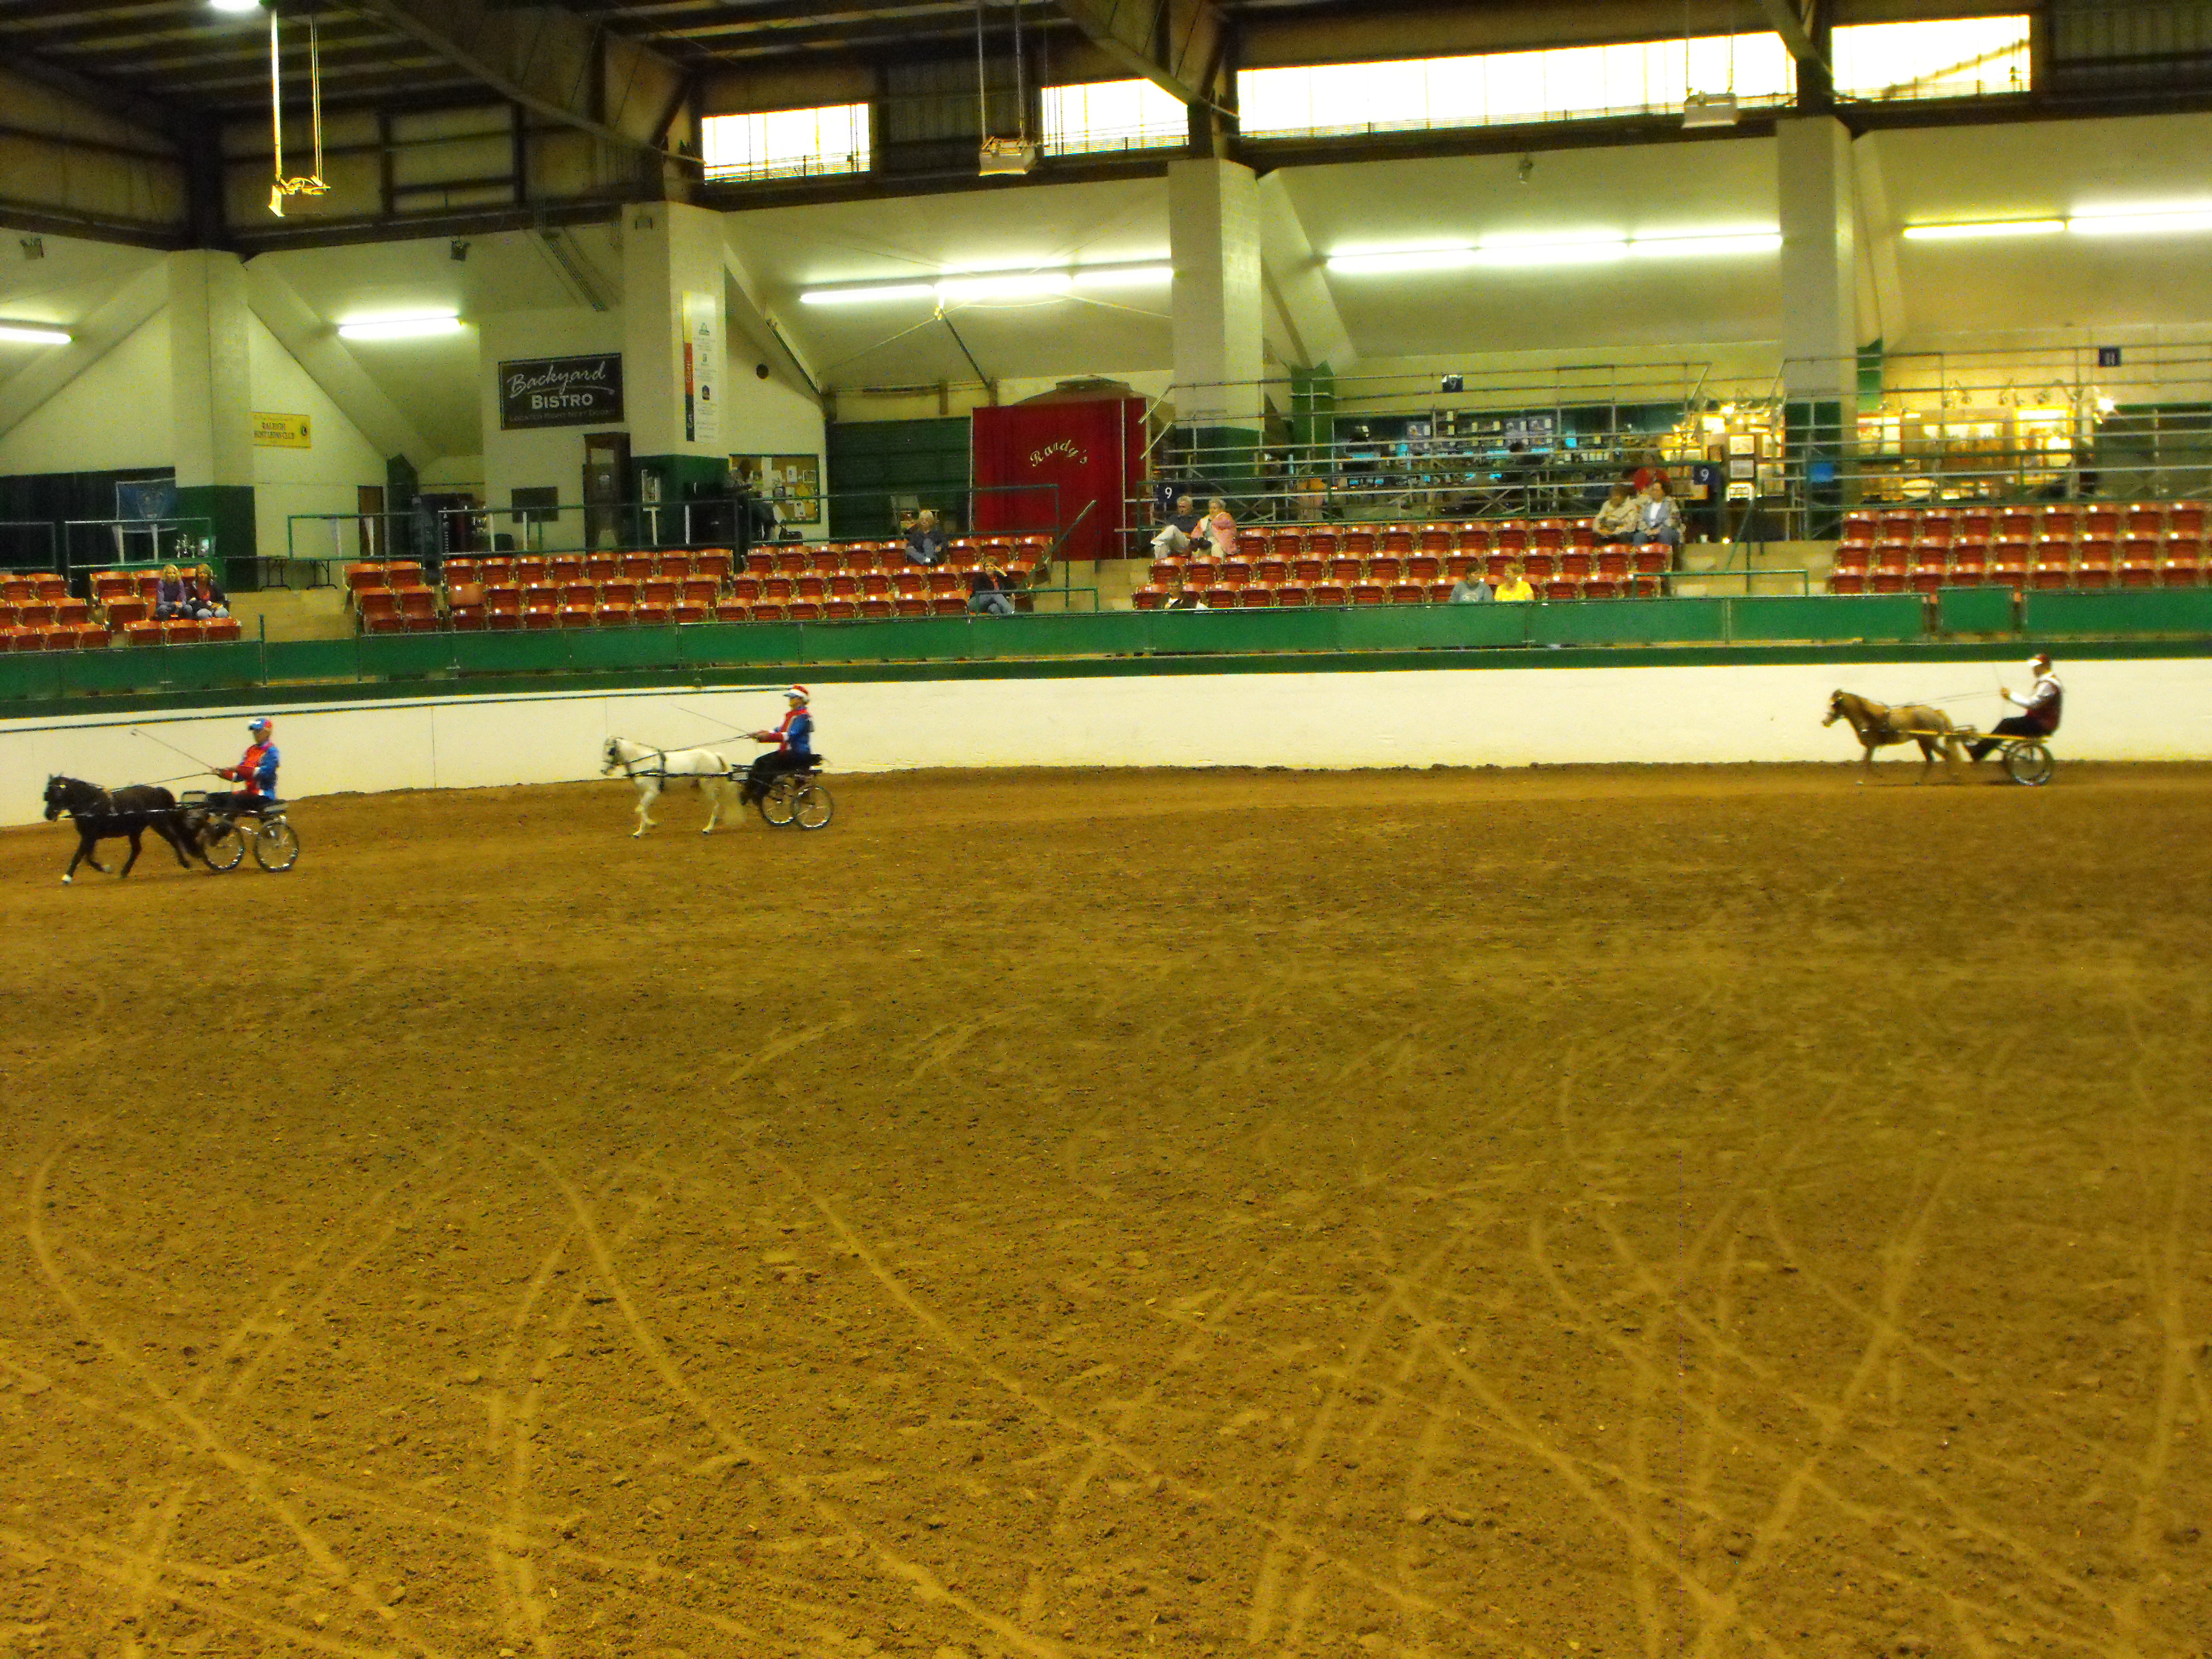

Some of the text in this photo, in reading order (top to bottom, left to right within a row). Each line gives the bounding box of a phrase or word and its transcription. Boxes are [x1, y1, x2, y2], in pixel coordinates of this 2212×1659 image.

[507, 361, 606, 399] Backyard
[531, 394, 593, 409] BISTRO
[1700, 468, 1709, 481] 9
[1165, 487, 1172, 499] 9
